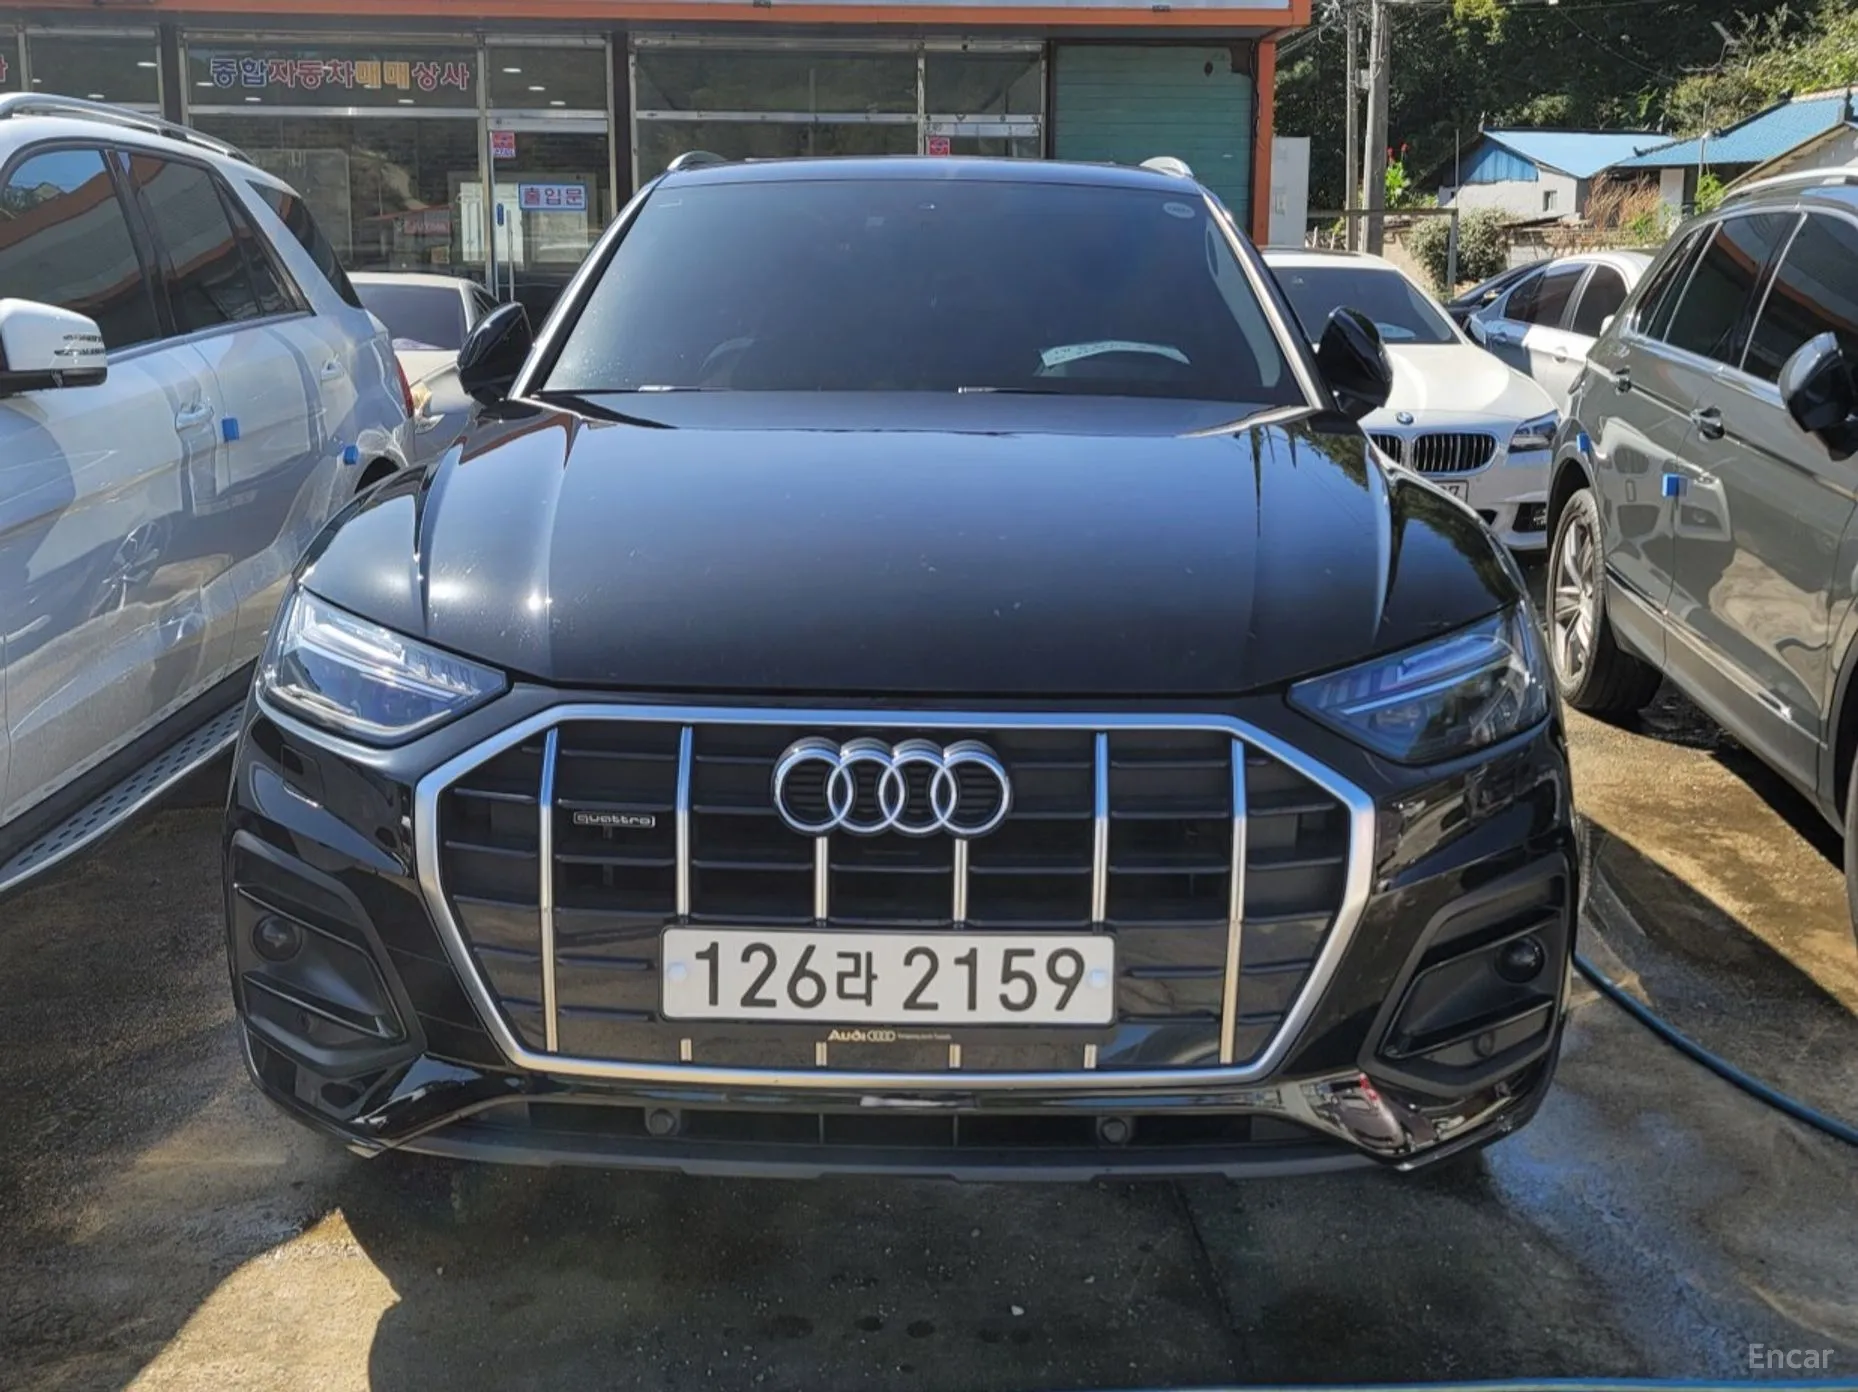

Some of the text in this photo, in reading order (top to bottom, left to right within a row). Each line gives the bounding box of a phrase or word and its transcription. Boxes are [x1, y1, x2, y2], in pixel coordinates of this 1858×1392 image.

[524, 187, 583, 206] 출입문
[577, 813, 651, 825] quattro
[695, 941, 1085, 1012] 126라 2159
[827, 1029, 866, 1041] Audi
